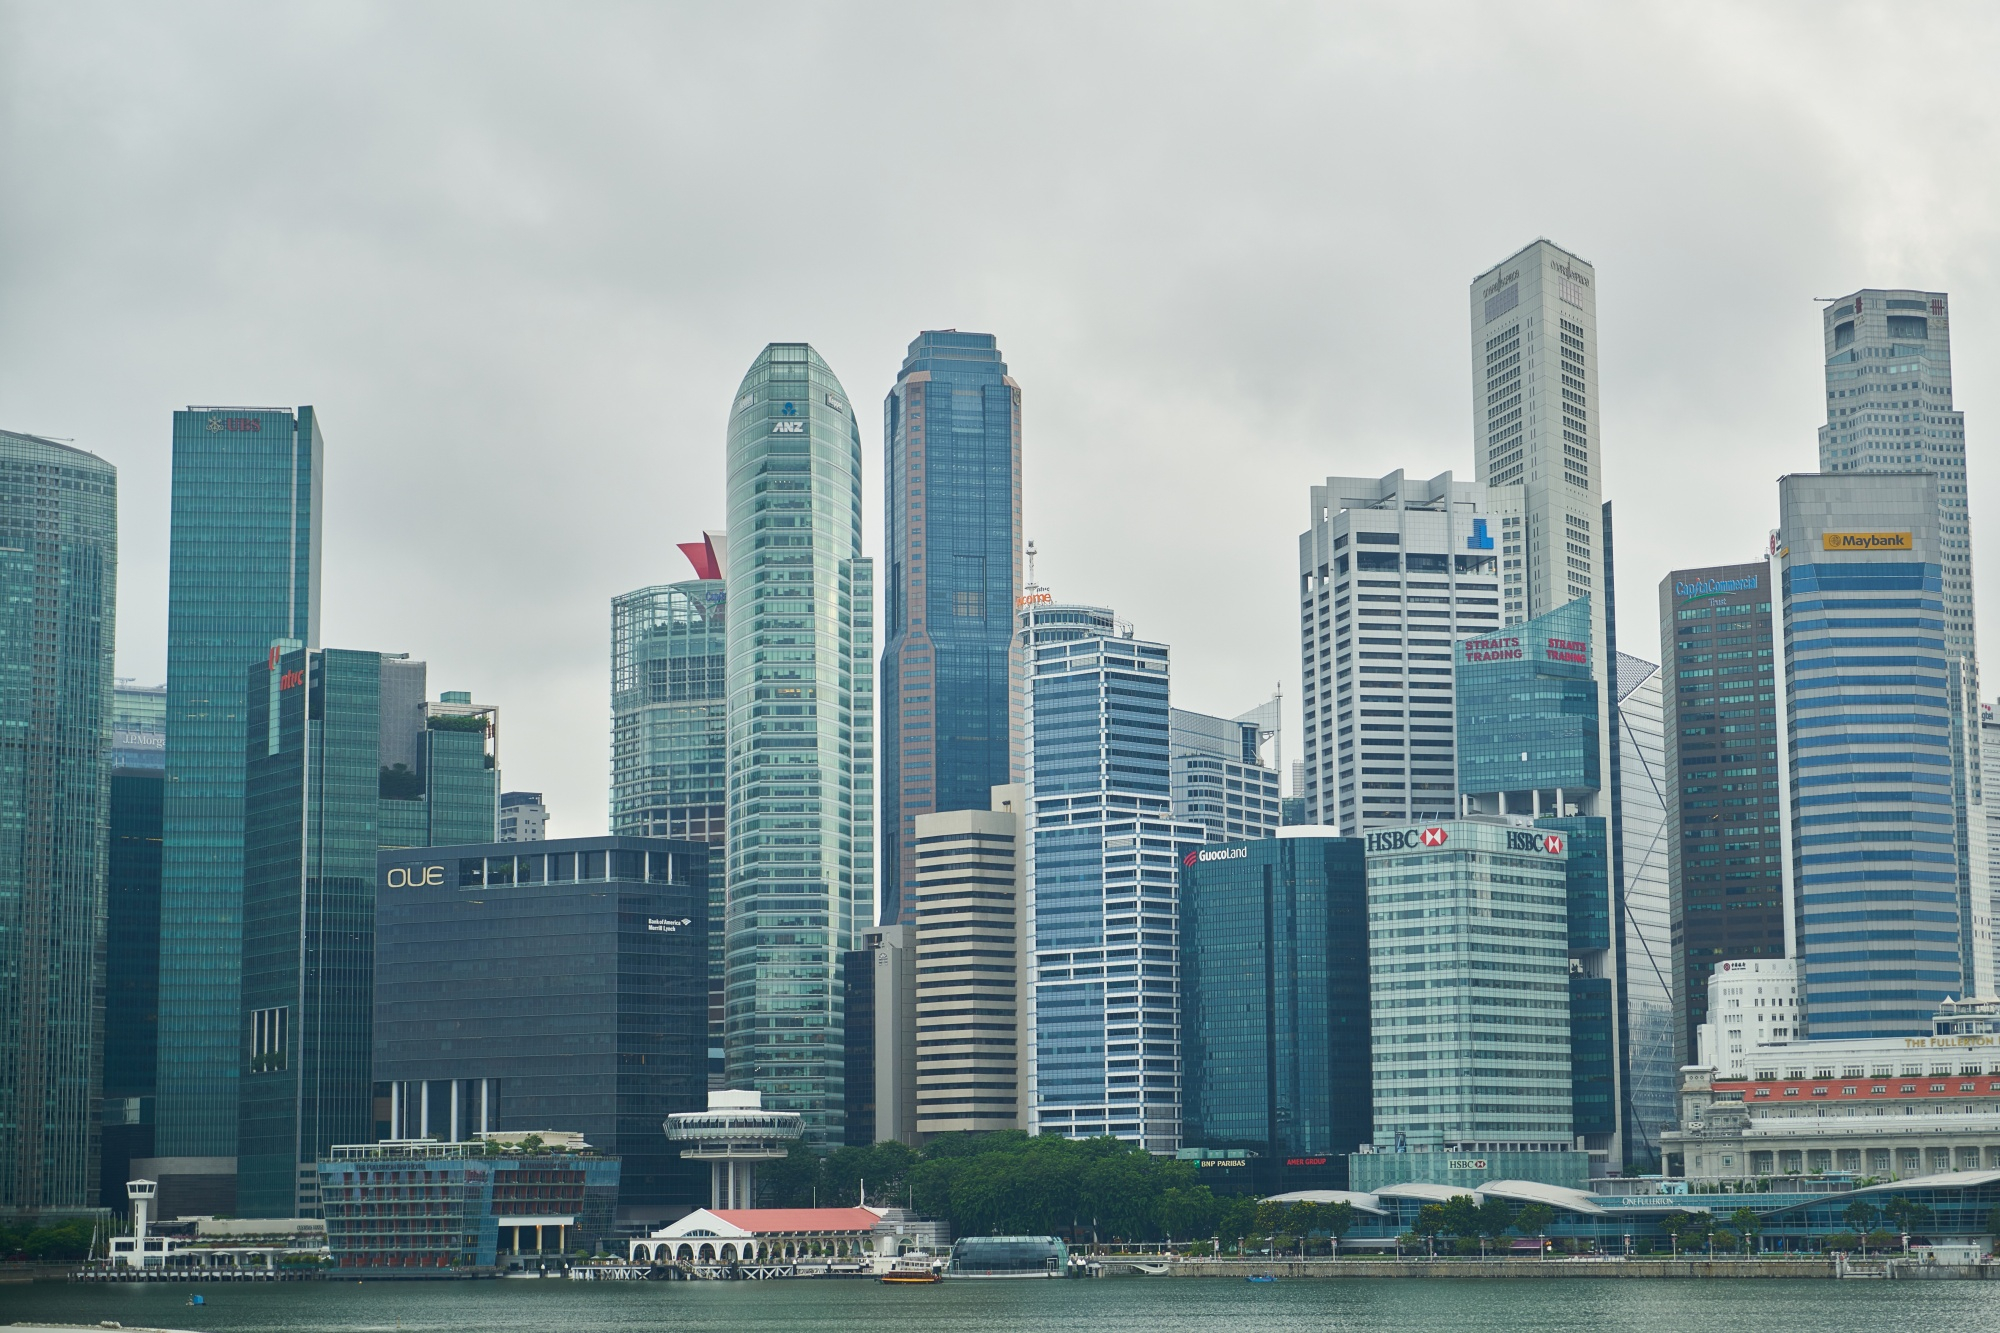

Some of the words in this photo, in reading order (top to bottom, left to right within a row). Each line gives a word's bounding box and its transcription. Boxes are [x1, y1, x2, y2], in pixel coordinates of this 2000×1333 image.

[227, 418, 260, 432] UBS
[772, 421, 804, 433] ANZ
[1842, 535, 1905, 548] Maybank
[1676, 575, 1758, 599] CapitaCommercial
[1708, 598, 1727, 607] Trust
[1465, 637, 1519, 650] STRAITS
[1548, 638, 1587, 652] STRAITS
[1465, 649, 1523, 662] TRADING
[1546, 649, 1587, 664] TRADING
[1367, 829, 1419, 852] HSBC
[1507, 831, 1544, 852] HSBC
[1199, 845, 1248, 862] GuocoLand
[387, 865, 445, 888] OUE
[1905, 1038, 1926, 1048] THE
[1930, 1036, 1994, 1047] FULLERTON
[1449, 1160, 1474, 1168] HSBC
